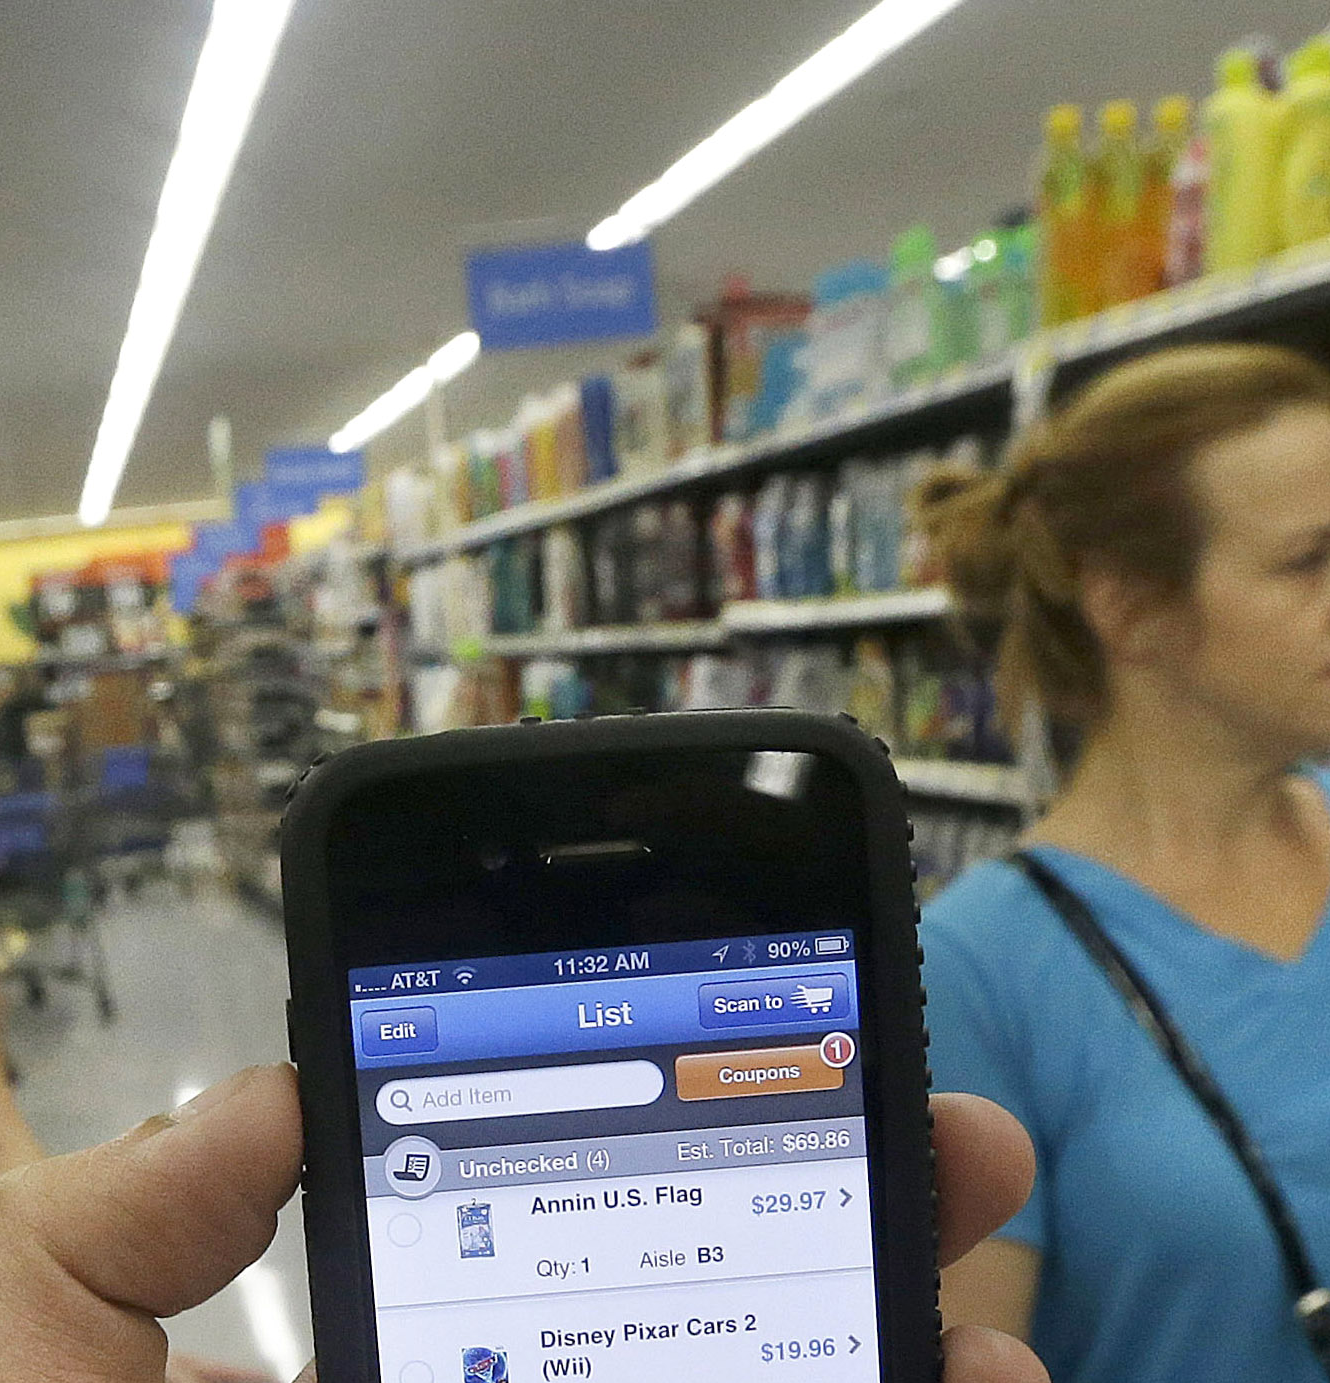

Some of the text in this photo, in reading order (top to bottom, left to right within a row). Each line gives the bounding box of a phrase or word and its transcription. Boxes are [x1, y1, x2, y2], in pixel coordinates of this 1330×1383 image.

[768, 941, 810, 959] 90%
[554, 951, 650, 976] 11:32 AM
[391, 970, 440, 990] AT&T
[578, 1001, 633, 1029] List
[714, 994, 783, 1014] Scan to
[380, 1023, 416, 1041] Edit
[830, 1039, 842, 1060] 1
[719, 1065, 801, 1085] Coupons
[423, 1087, 512, 1108] Add Item
[677, 1129, 851, 1161] Est. Total: $69.86
[459, 1149, 610, 1179] Unchecked (4)
[531, 1186, 703, 1215] Annin U.S. Flag
[751, 1190, 827, 1216] $29.97
[536, 1257, 591, 1280] Qty: 1
[640, 1247, 724, 1268] Aisle B3
[540, 1314, 757, 1348] Disney Pixar Cars 2
[761, 1338, 836, 1363] $19.96
[542, 1357, 592, 1381] (Wii)
